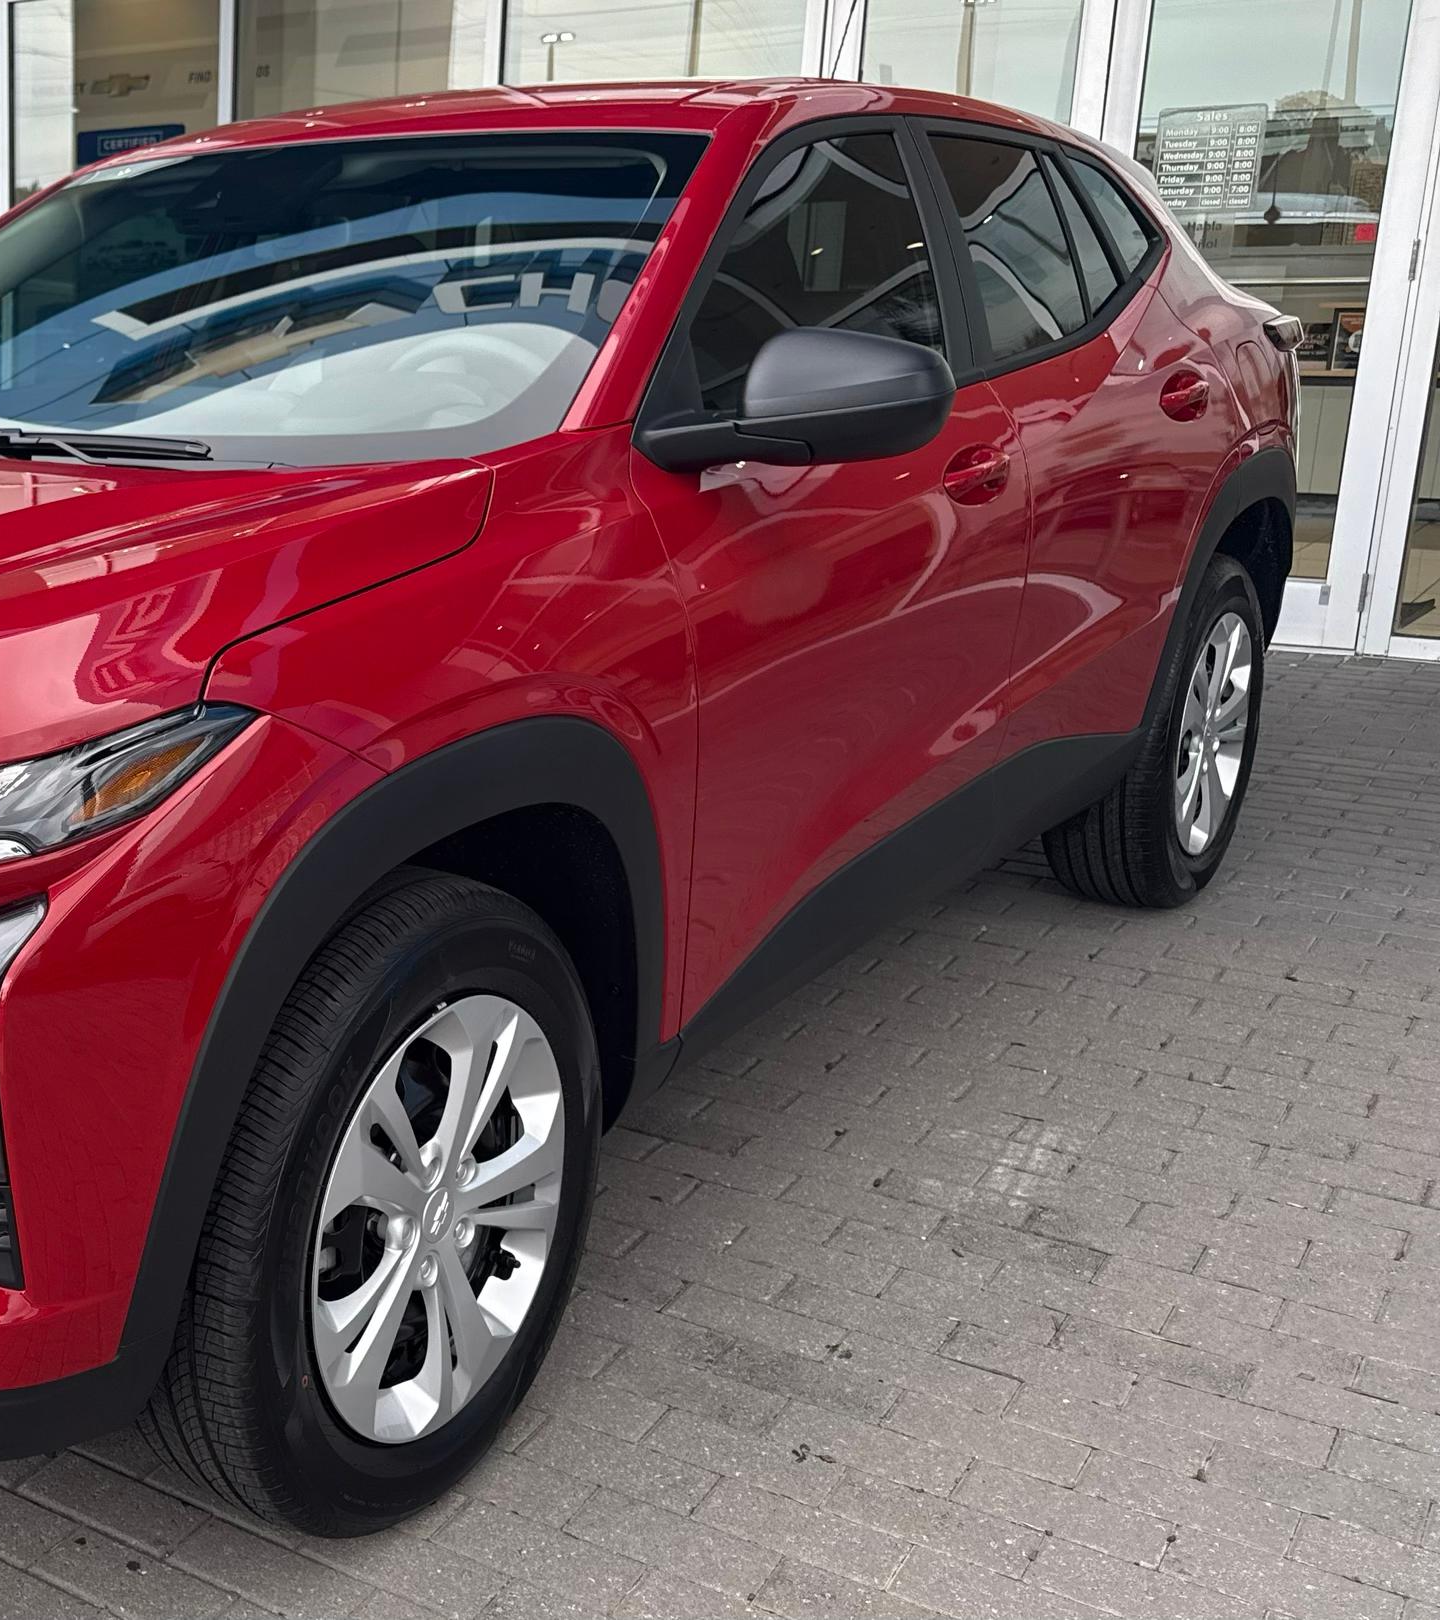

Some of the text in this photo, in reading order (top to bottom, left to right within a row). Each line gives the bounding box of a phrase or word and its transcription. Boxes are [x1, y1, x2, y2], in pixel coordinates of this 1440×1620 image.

[1197, 111, 1228, 122] Sales
[1165, 128, 1198, 137] Monday
[102, 136, 158, 150] CERTIFIED
[1165, 140, 1198, 149] Tuesday
[1210, 138, 1228, 146] 9:00
[1238, 137, 1256, 145] 8:00
[1163, 152, 1205, 161] Wednesday
[1208, 150, 1226, 158] 9:00
[1236, 149, 1254, 157] 8:00
[1162, 163, 1199, 172] Thursday
[1207, 162, 1225, 170] 9:00
[1234, 161, 1252, 169] 8:00
[1160, 176, 1186, 184] Friday
[1205, 174, 1223, 182] 9:00
[1233, 173, 1251, 181] 8:00
[1159, 187, 1195, 196] Saturday
[1203, 186, 1222, 194] 9:00
[1231, 185, 1250, 193] 7:00
[1164, 199, 1187, 209] nday
